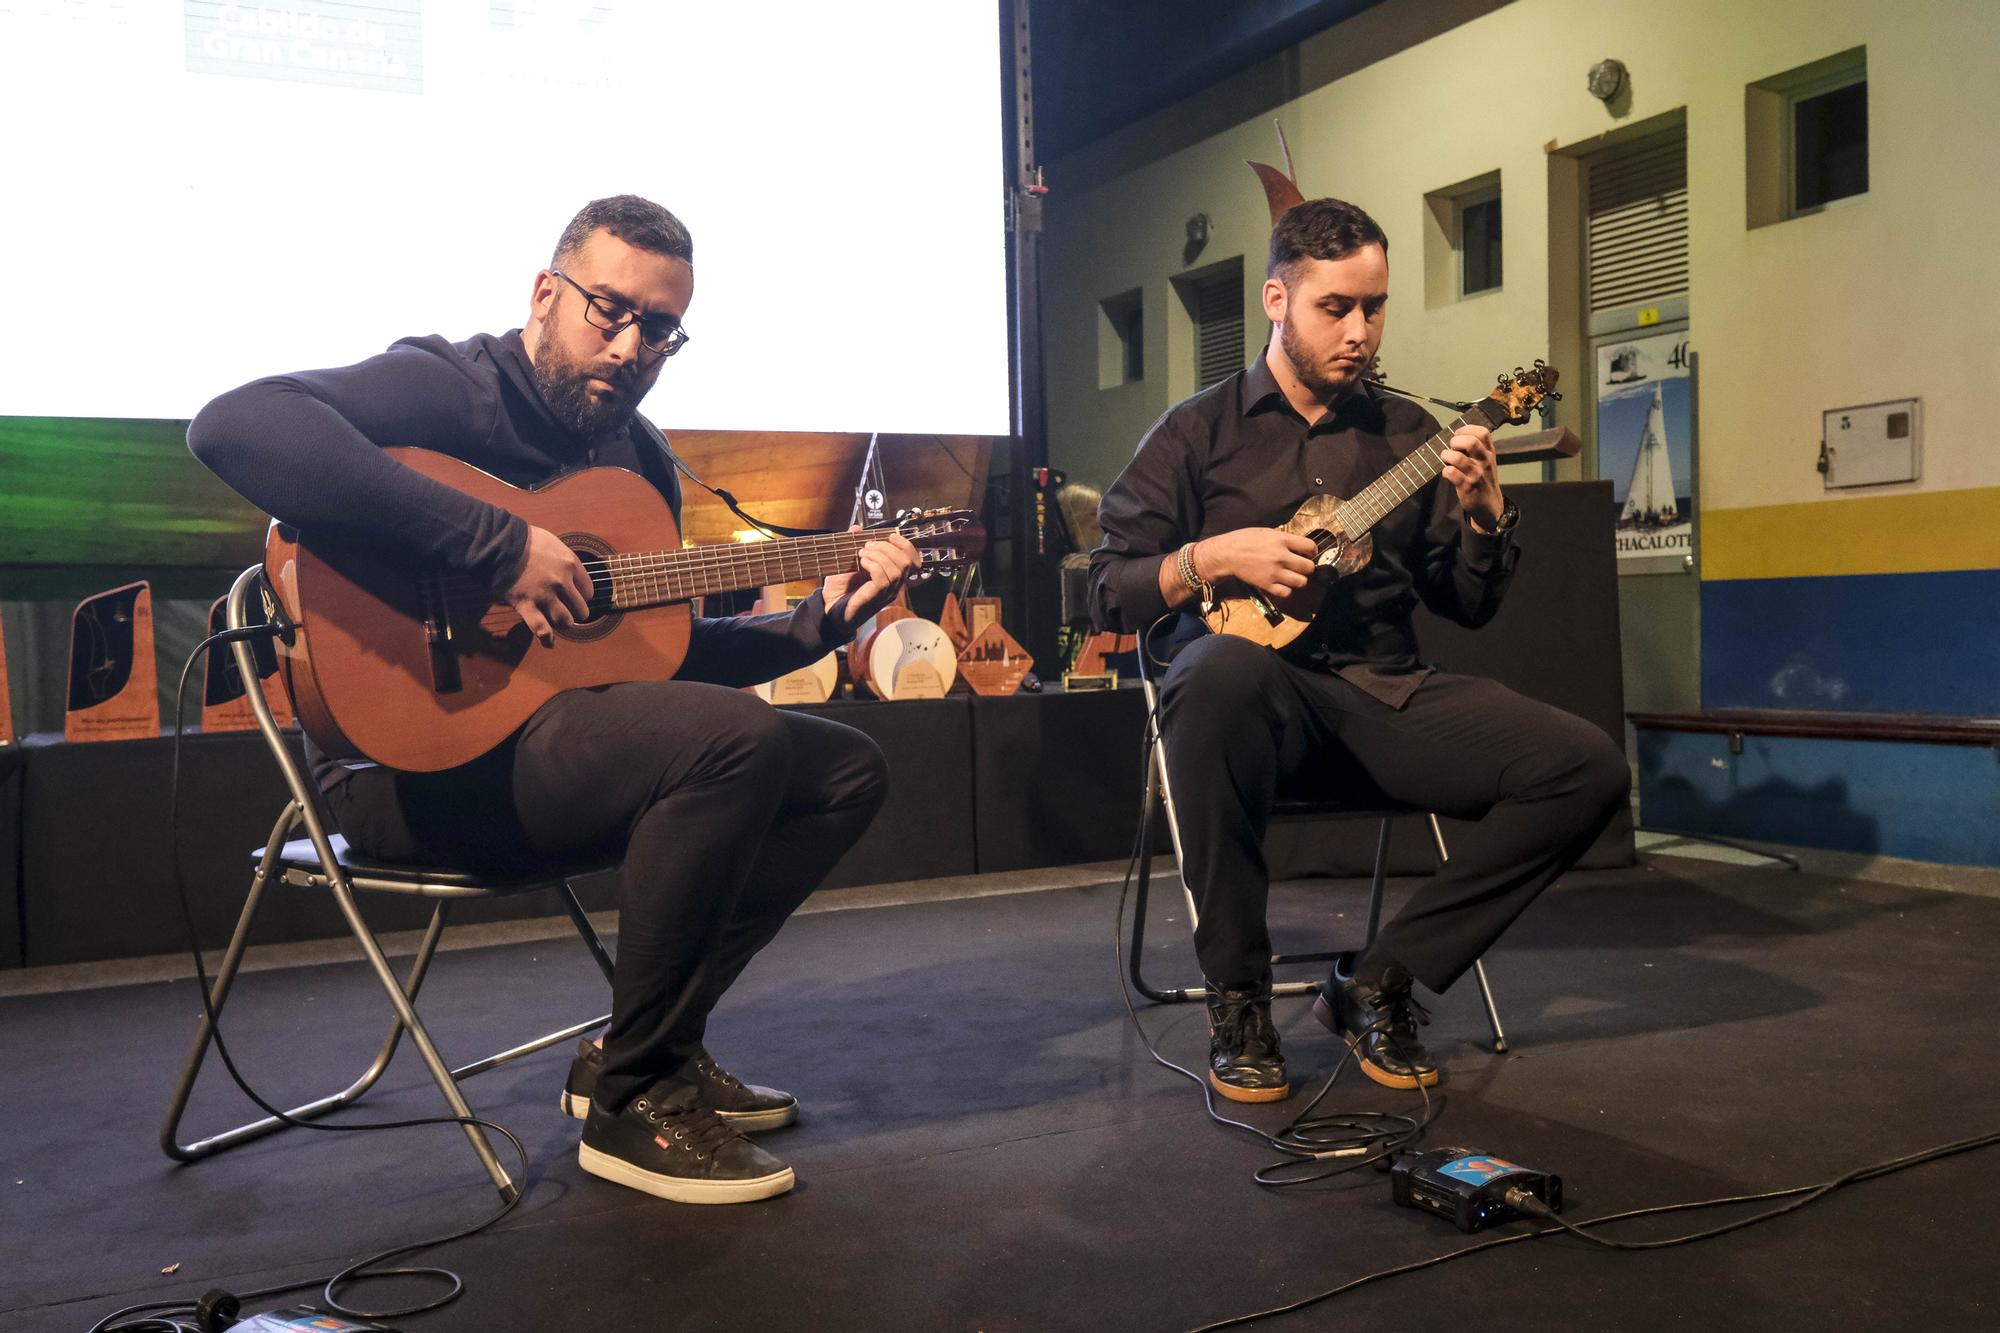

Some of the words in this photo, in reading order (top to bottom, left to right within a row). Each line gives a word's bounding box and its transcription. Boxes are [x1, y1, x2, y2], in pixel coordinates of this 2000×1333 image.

[218, 5, 338, 39] Cabildo
[349, 18, 386, 46] de
[203, 30, 282, 63] Gran
[289, 39, 408, 76] Canaria
[1841, 416, 1851, 430] 5
[1616, 534, 1692, 552] HACALOT
